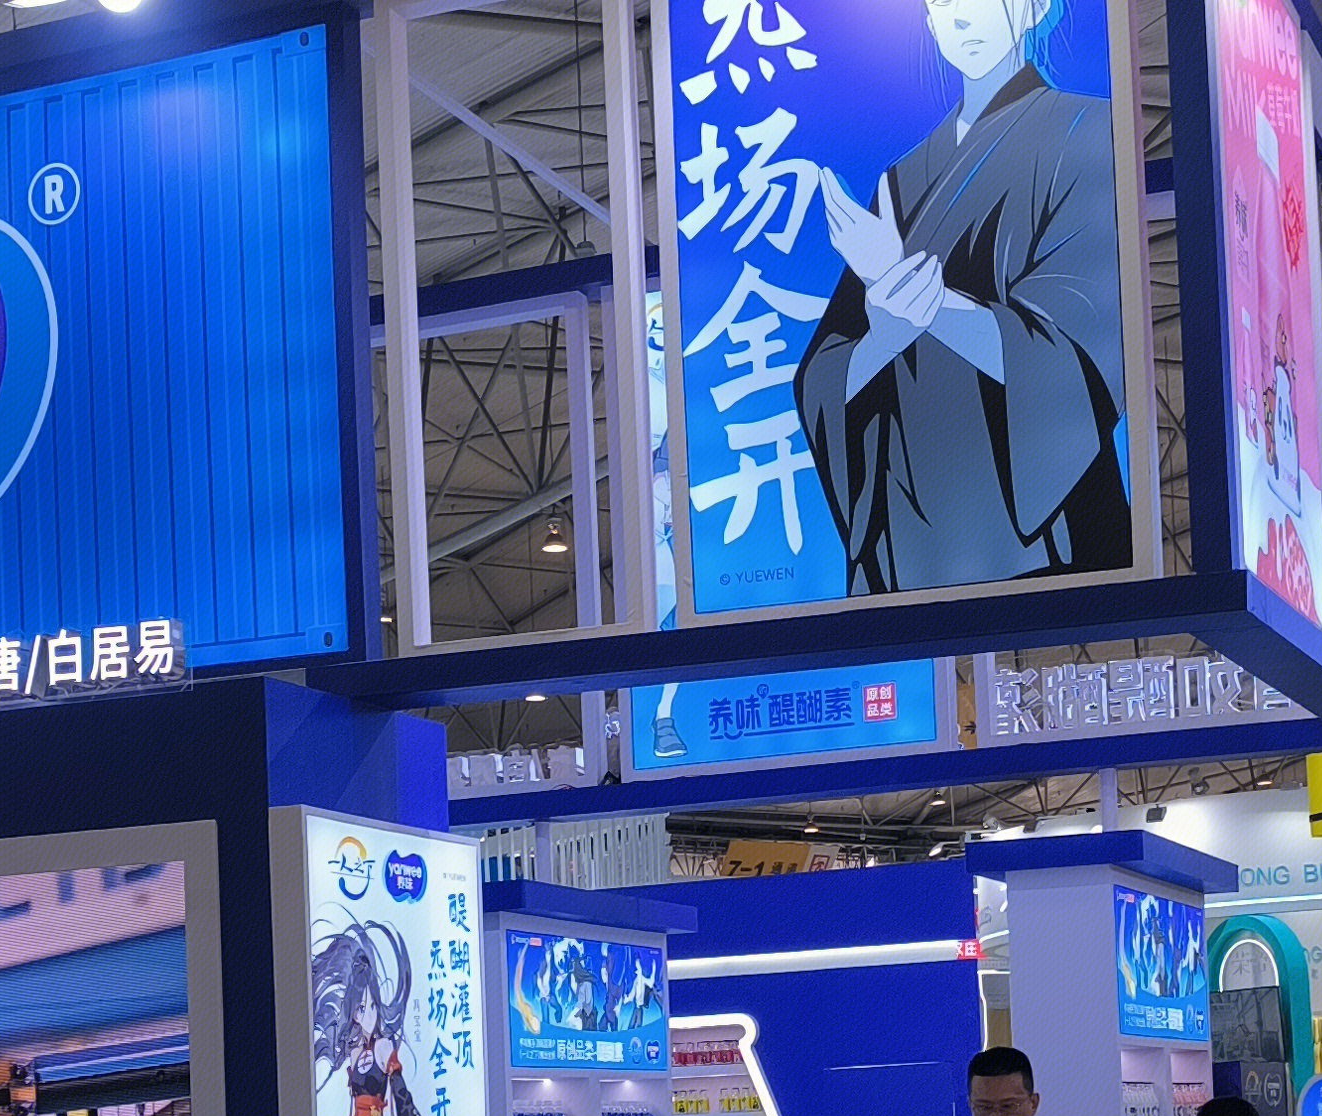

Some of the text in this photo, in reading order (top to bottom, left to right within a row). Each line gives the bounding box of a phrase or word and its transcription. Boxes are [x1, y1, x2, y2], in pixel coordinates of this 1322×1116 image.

[735, 567, 795, 584] YUEWEN
[866, 685, 892, 702] 原创
[867, 702, 894, 717] 品类
[447, 892, 475, 1069] 醍醐灌顶
